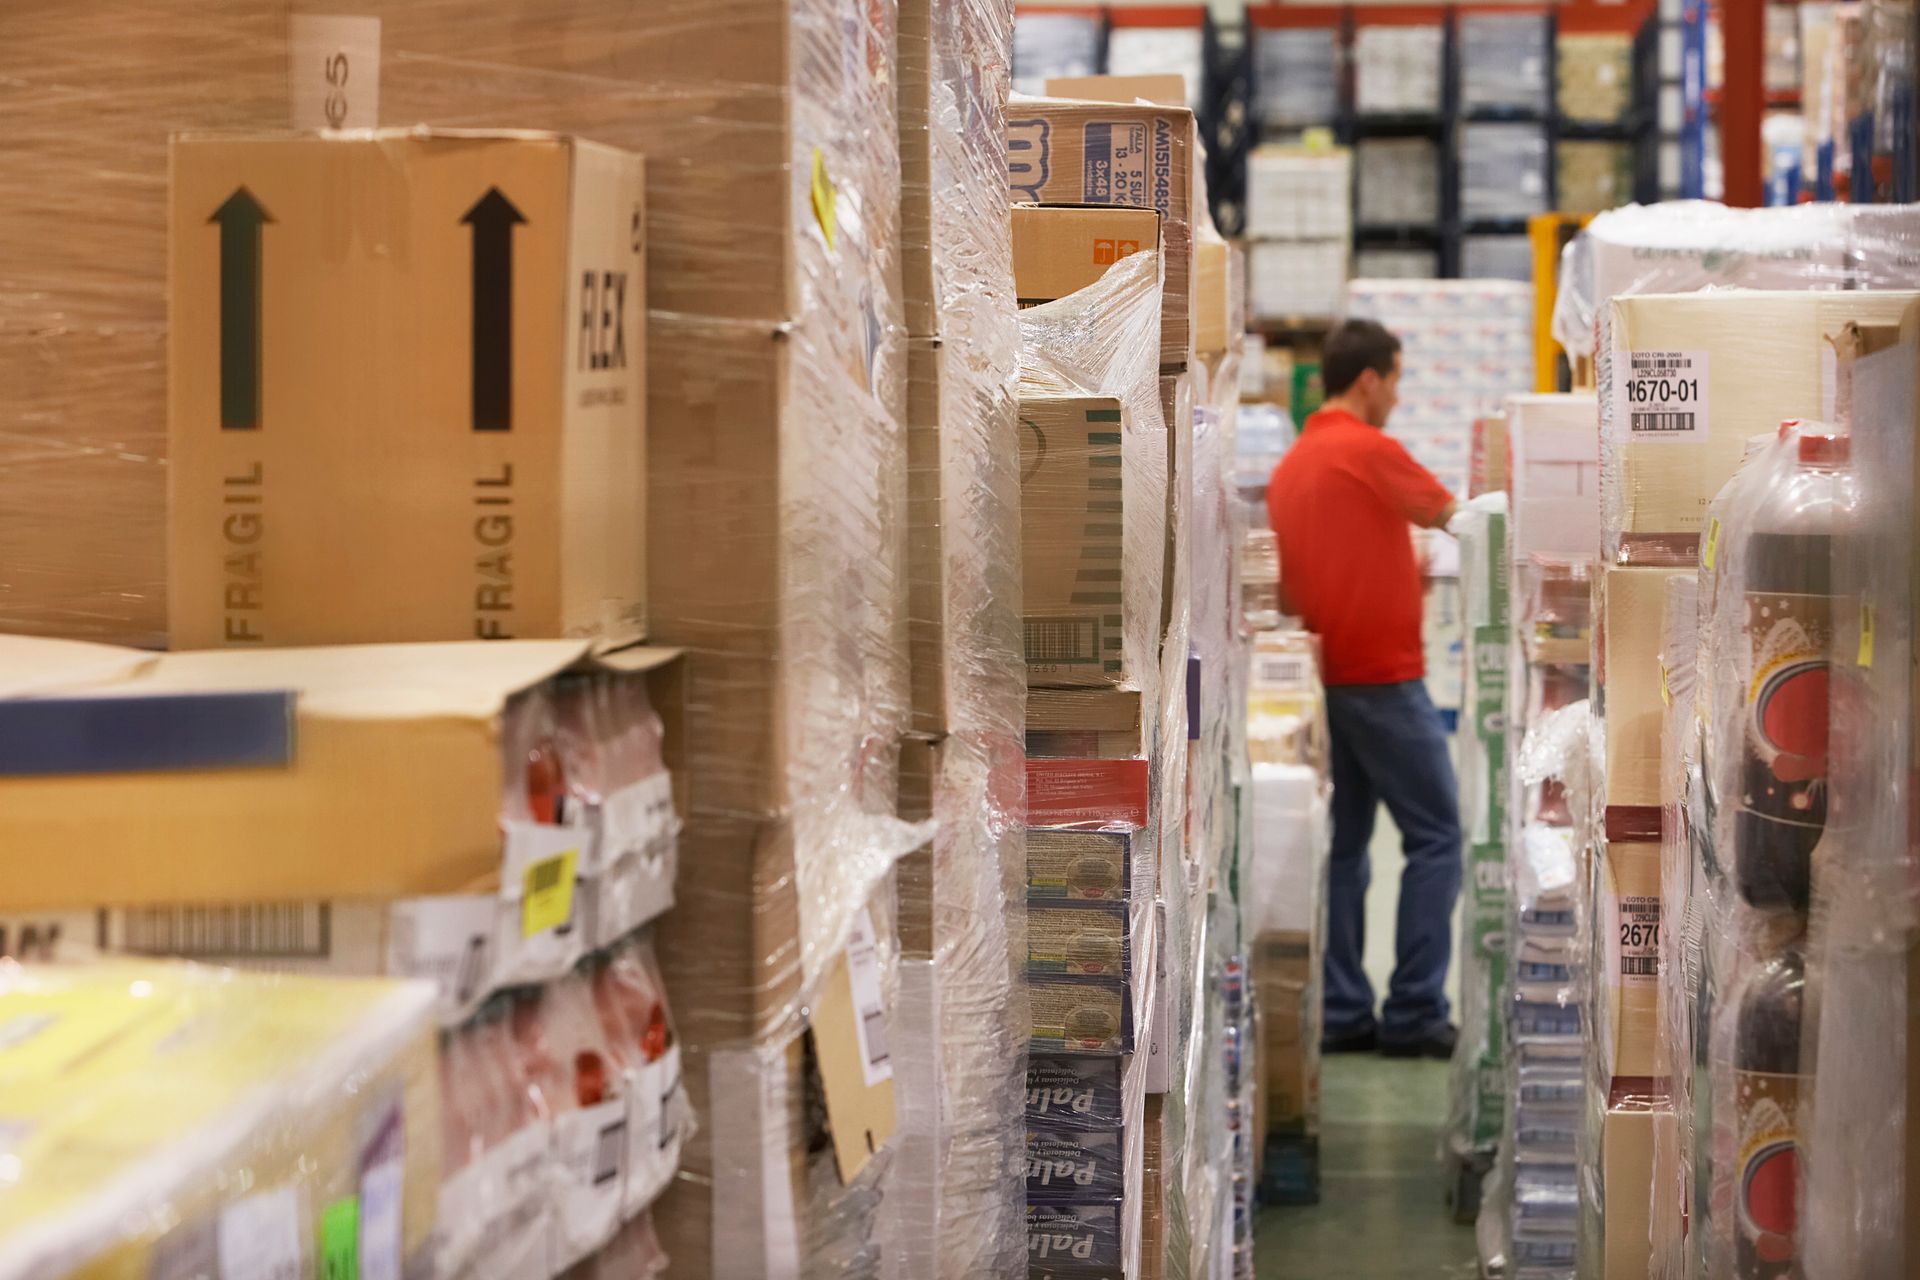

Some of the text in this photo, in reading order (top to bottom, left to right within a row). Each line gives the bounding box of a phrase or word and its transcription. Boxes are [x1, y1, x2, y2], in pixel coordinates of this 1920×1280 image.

[1115, 146, 1127, 159] 13
[1135, 126, 1143, 154] TALLA
[1095, 160, 1108, 196] 3x48
[1115, 171, 1127, 189] 20
[1130, 181, 1142, 206] SUP
[578, 271, 627, 371] FLEX
[225, 461, 264, 642] FRAGIL
[475, 462, 514, 640] FRAGIL
